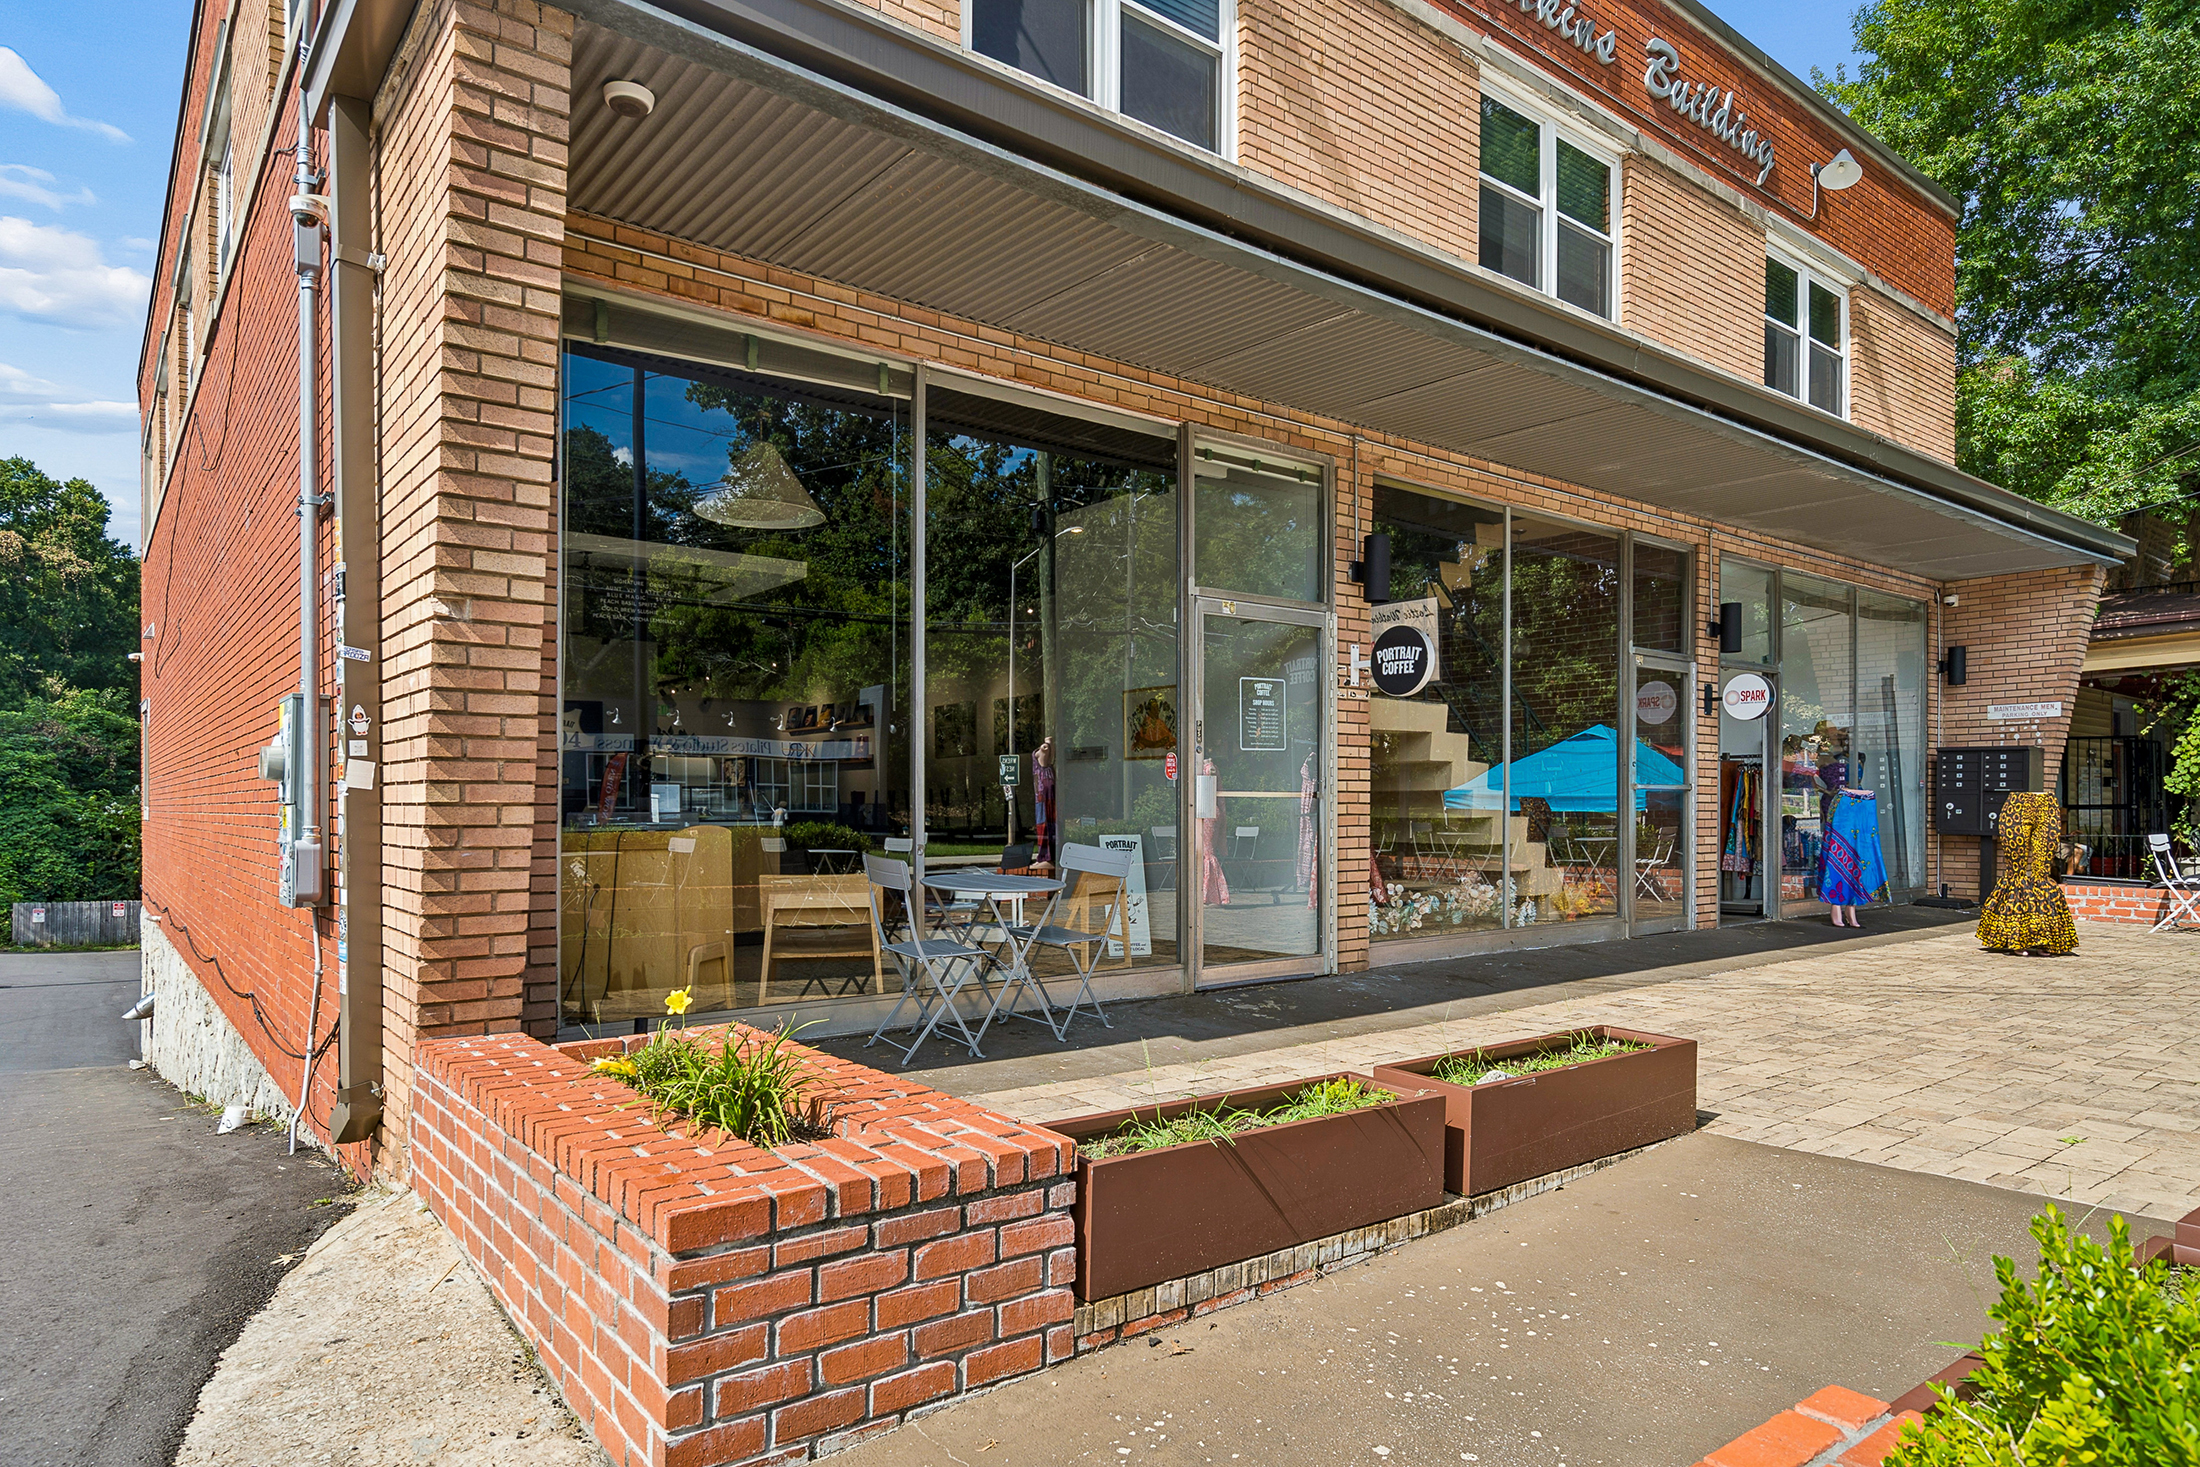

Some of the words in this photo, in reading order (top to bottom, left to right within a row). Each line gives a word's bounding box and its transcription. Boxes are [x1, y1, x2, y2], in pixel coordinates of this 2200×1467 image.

[1644, 37, 1775, 186] Building
[1376, 646, 1422, 664] PORTRAIT
[1382, 660, 1415, 675] COFFEE
[1254, 682, 1273, 690] PORTRAIT
[1740, 690, 1766, 702] SPARK
[1993, 704, 2038, 712] MAINTENANCE
[1105, 840, 1137, 850] PORTRAIT
